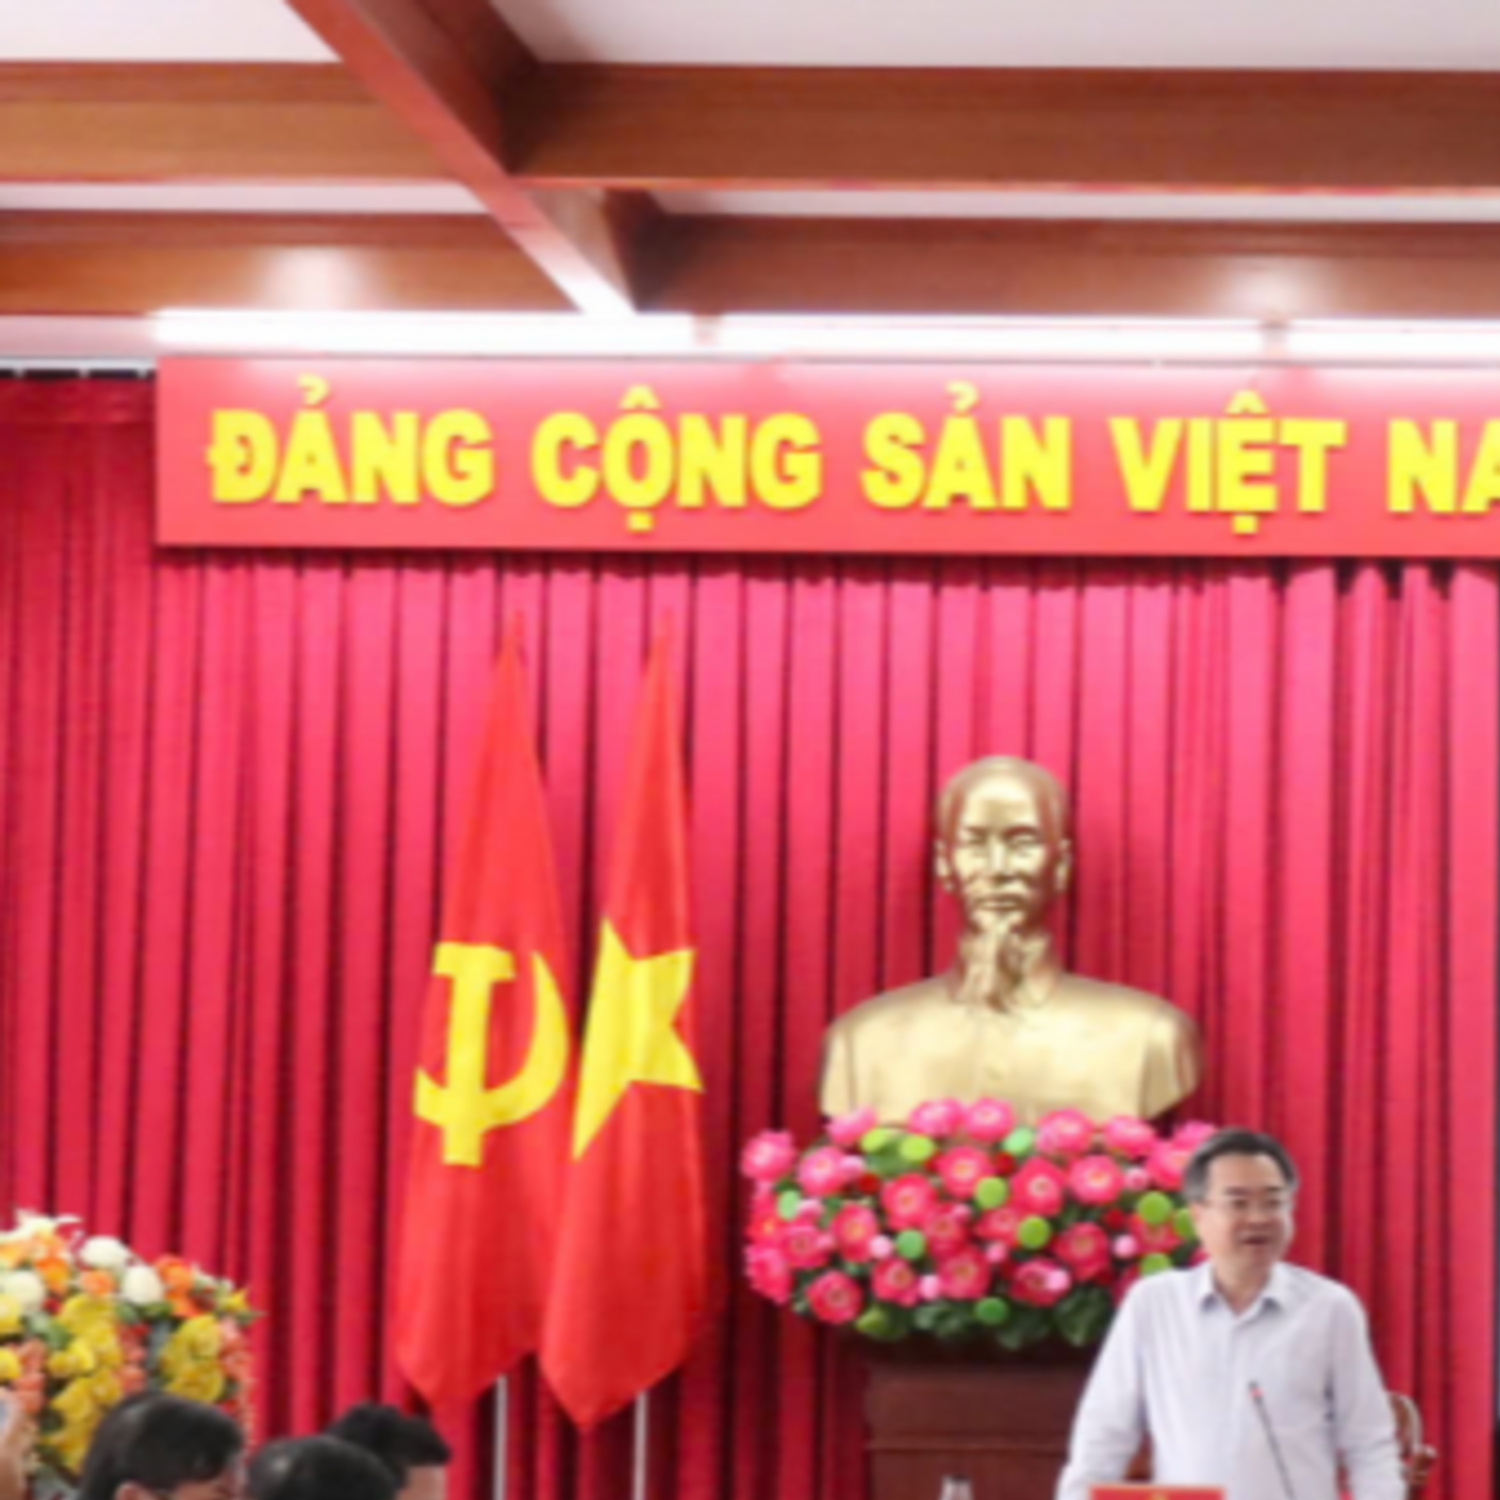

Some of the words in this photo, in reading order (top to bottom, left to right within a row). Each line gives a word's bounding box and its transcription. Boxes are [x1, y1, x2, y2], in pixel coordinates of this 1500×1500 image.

[209, 377, 494, 504] ĐẢNG
[530, 384, 822, 530] CỘNG
[861, 382, 1073, 511] SẢN
[1111, 390, 1345, 534] VIỆT
